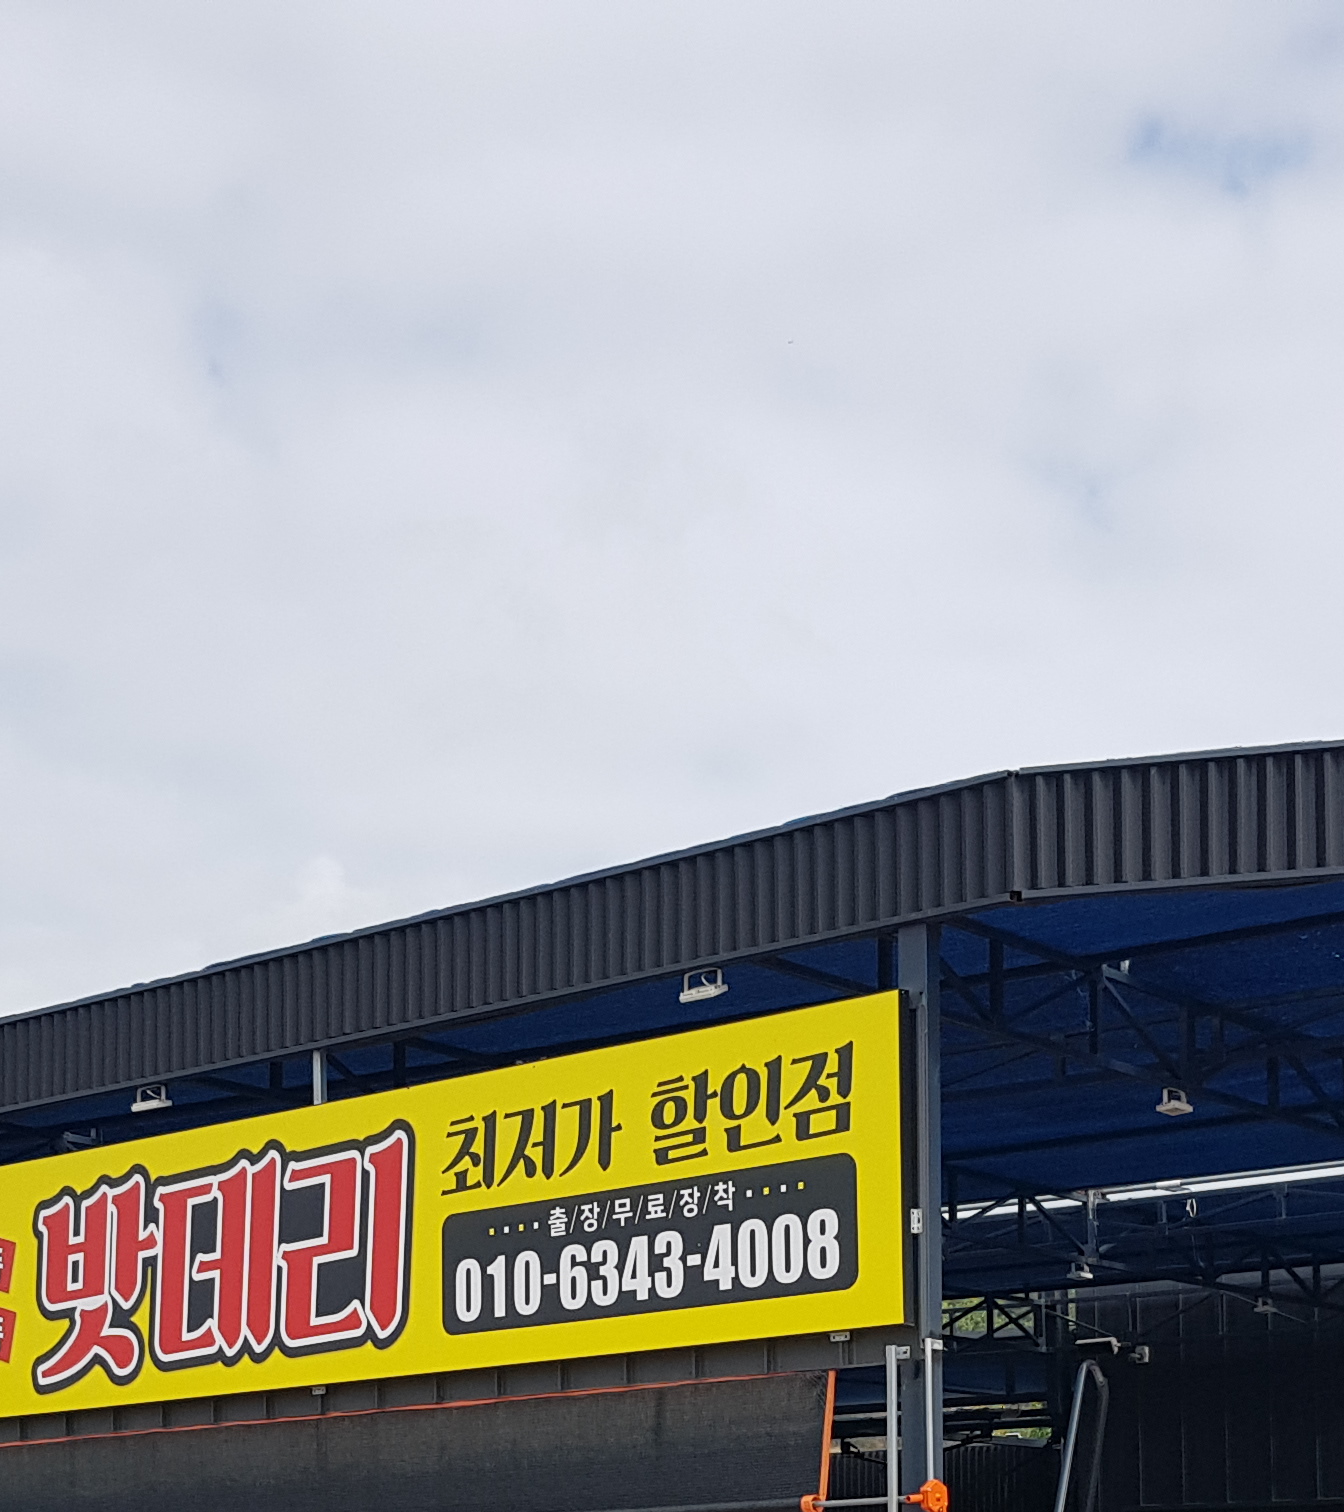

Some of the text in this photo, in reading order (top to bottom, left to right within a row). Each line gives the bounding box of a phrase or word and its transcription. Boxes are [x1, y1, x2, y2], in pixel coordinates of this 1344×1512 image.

[441, 1039, 855, 1197] 최저가 할인점
[35, 1127, 411, 1388] 밧데리
[454, 1207, 841, 1323] 010-6343-4008
